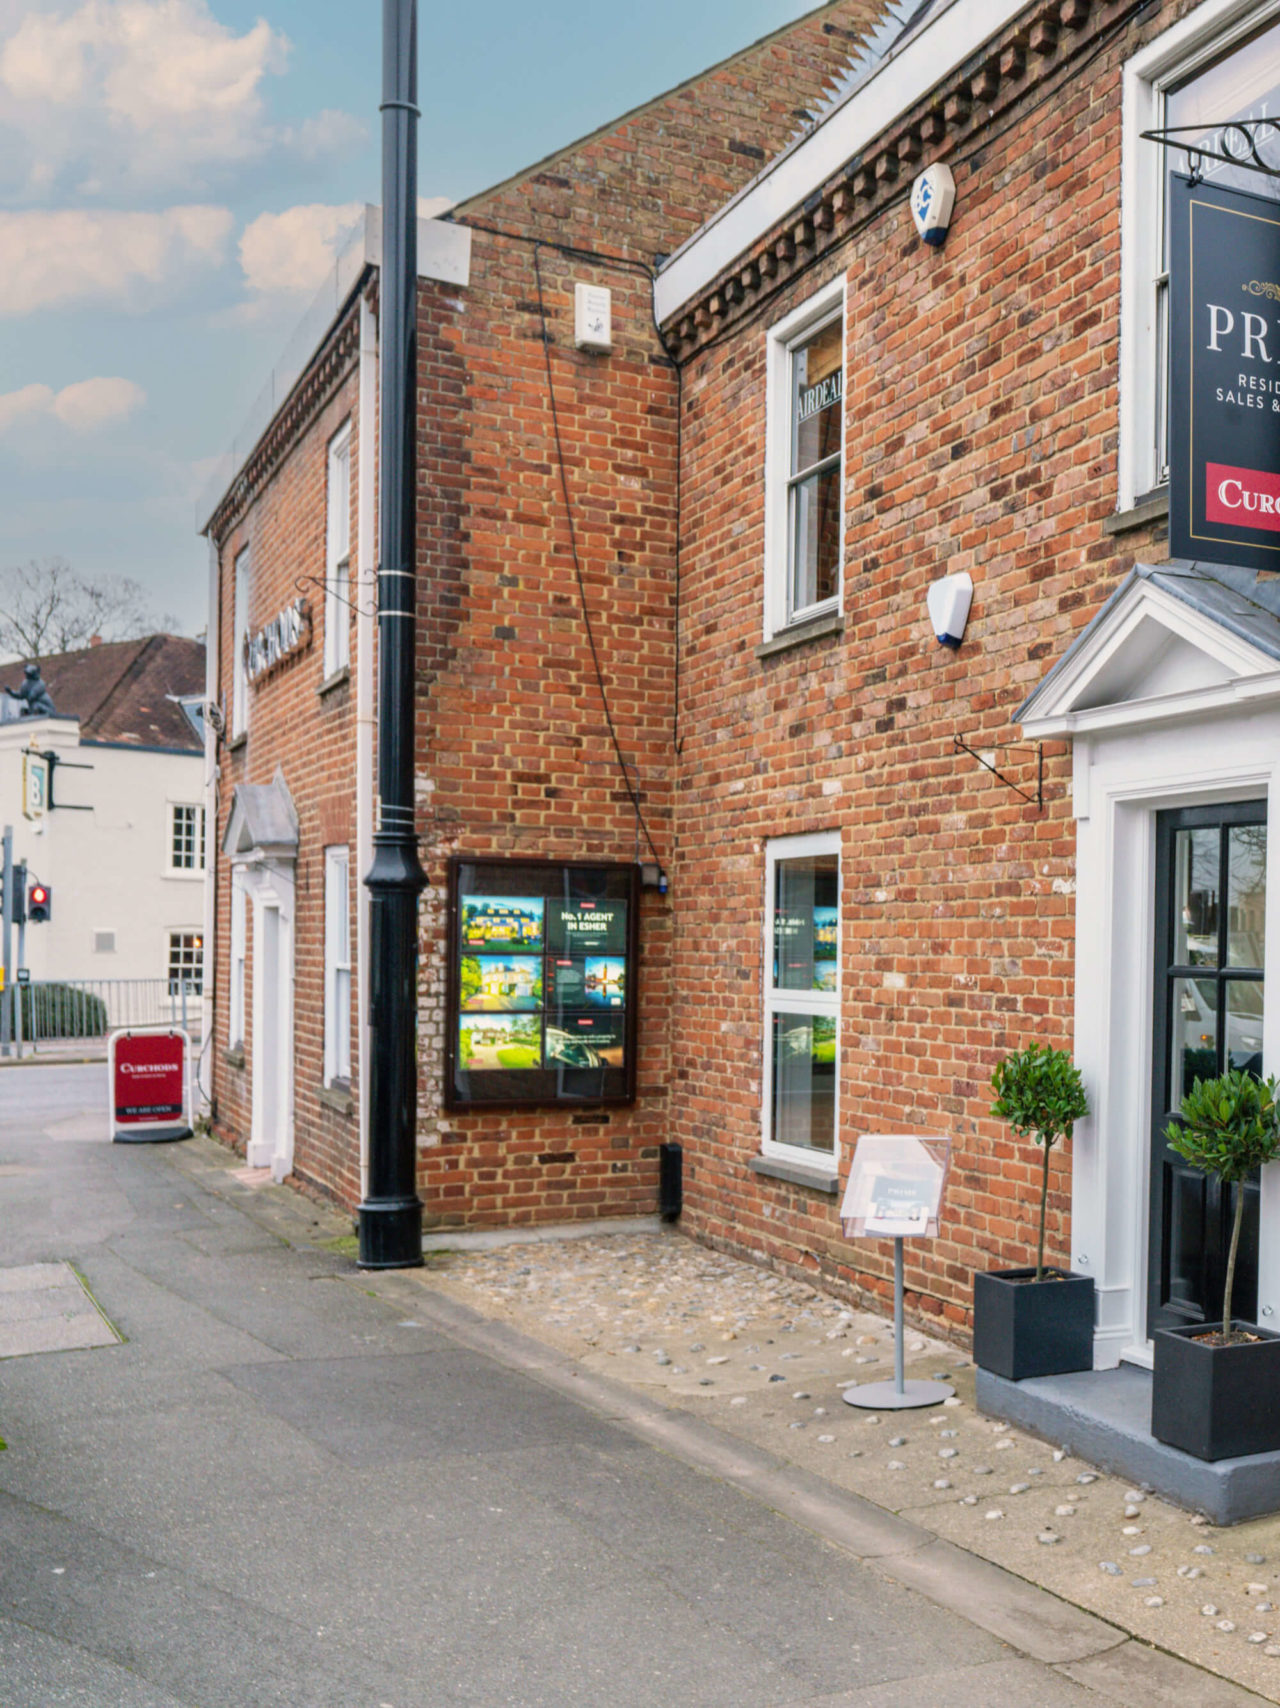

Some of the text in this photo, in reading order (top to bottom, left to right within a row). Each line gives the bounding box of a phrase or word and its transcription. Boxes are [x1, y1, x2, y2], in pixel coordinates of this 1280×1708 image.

[1215, 387, 1264, 410] SALES
[1272, 399, 1280, 413] &
[584, 912, 614, 922] AGENT
[567, 922, 607, 931] IN ESHER
[120, 1062, 179, 1074] CURCHODS
